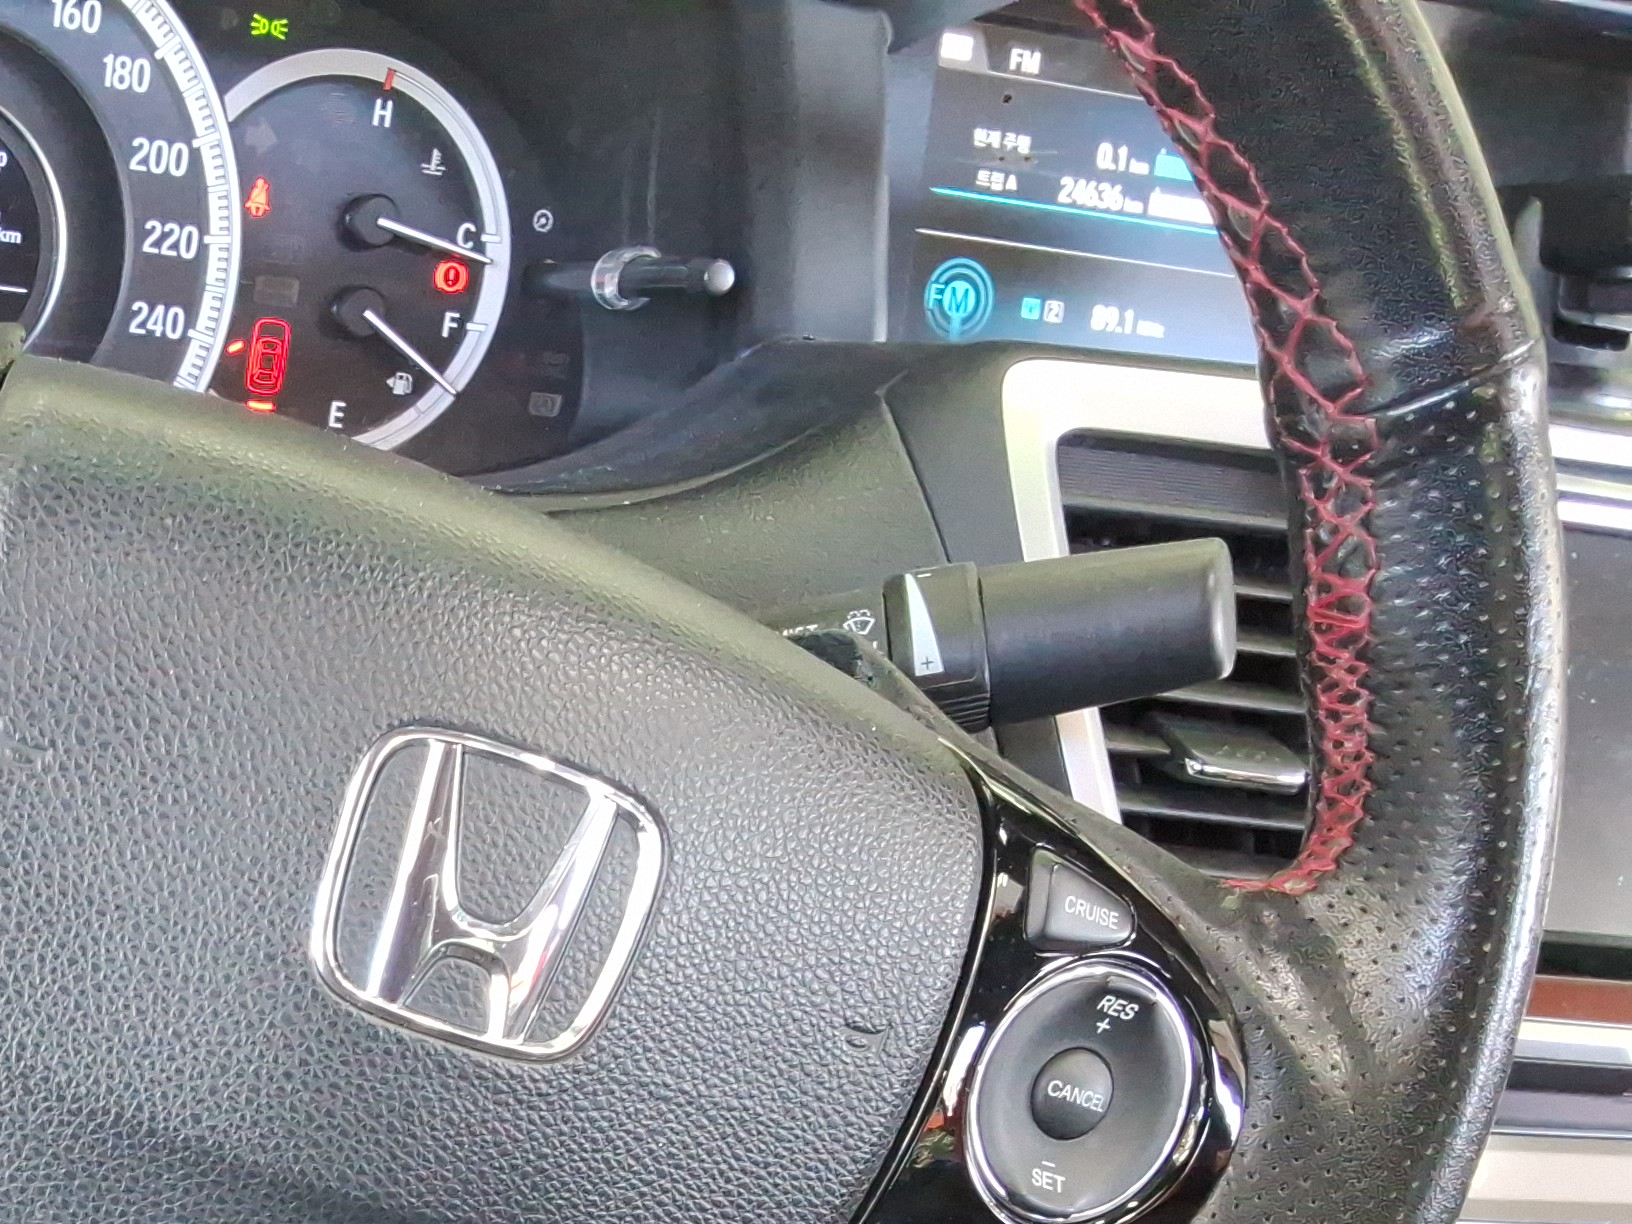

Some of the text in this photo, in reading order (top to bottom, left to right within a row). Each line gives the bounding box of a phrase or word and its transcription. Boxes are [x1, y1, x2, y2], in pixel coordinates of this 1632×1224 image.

[51, 0, 102, 34] 160
[103, 53, 151, 93] 180
[1009, 48, 1041, 75] FM
[372, 99, 394, 128] H
[130, 138, 189, 177] 200
[1097, 143, 1129, 172] 0.1
[1058, 176, 1125, 212] 24636
[143, 220, 198, 260] 220
[457, 224, 476, 247] C
[129, 301, 185, 340] 240
[441, 312, 461, 338] F
[325, 401, 346, 431] E
[1064, 895, 1119, 931] CRUISE
[1096, 993, 1139, 1021] RES
[1047, 1079, 1104, 1114] CANCEL
[1031, 1167, 1066, 1193] SET
